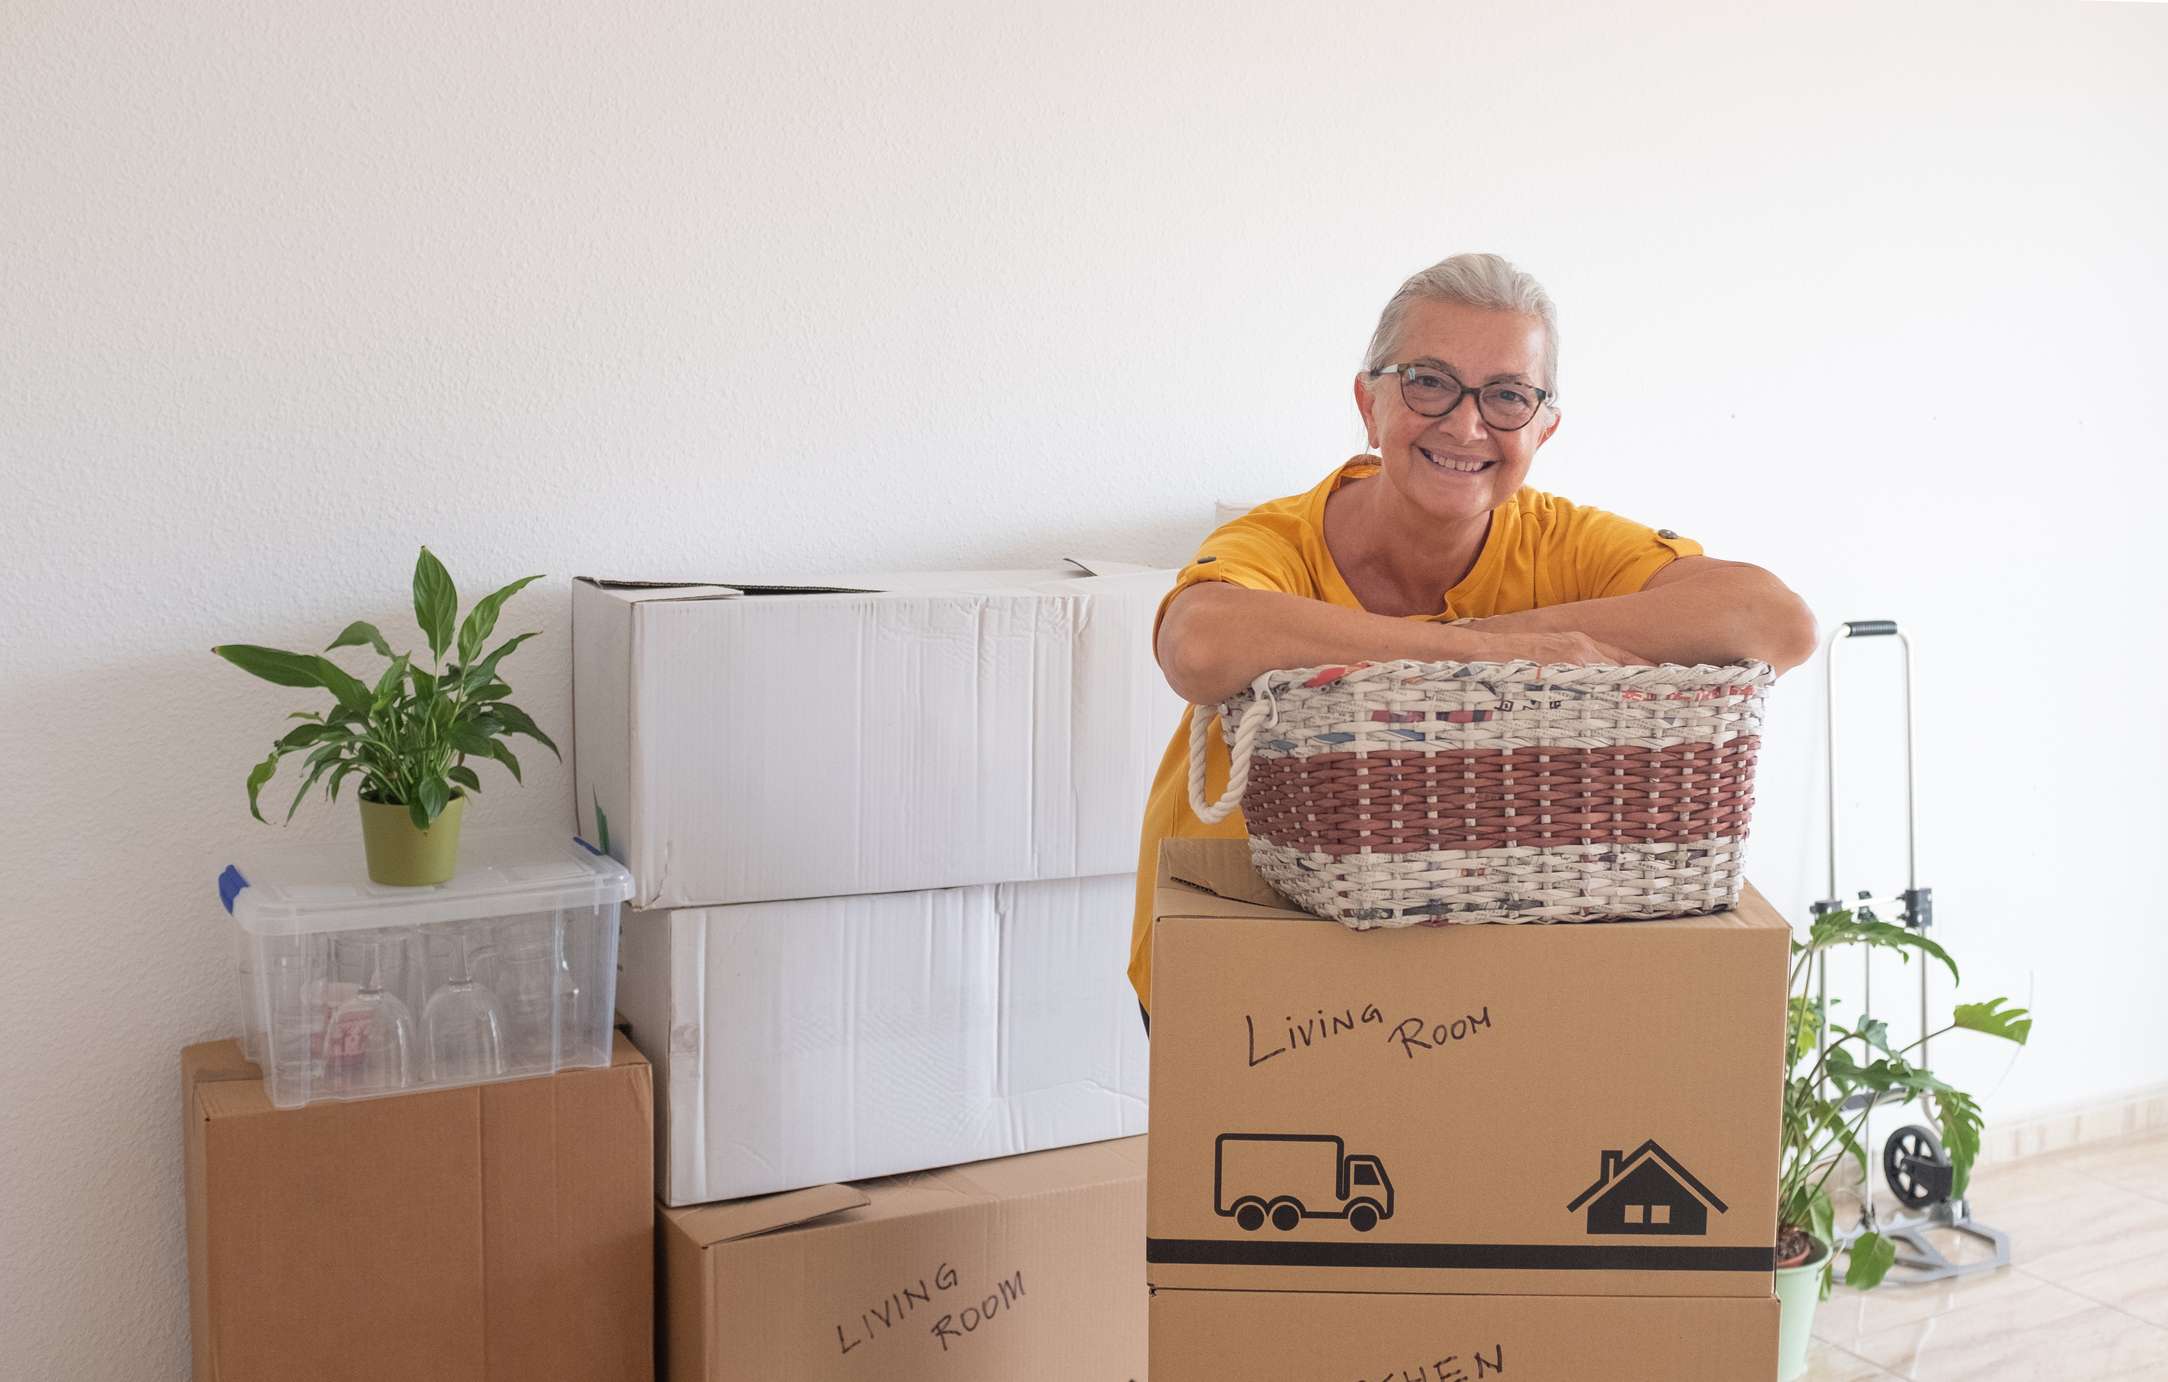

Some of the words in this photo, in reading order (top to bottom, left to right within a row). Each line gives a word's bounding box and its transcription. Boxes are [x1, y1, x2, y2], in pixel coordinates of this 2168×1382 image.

[1387, 1006, 1492, 1060] ROOM
[836, 1262, 958, 1355] LIVING
[930, 1270, 1026, 1352] ROOM
